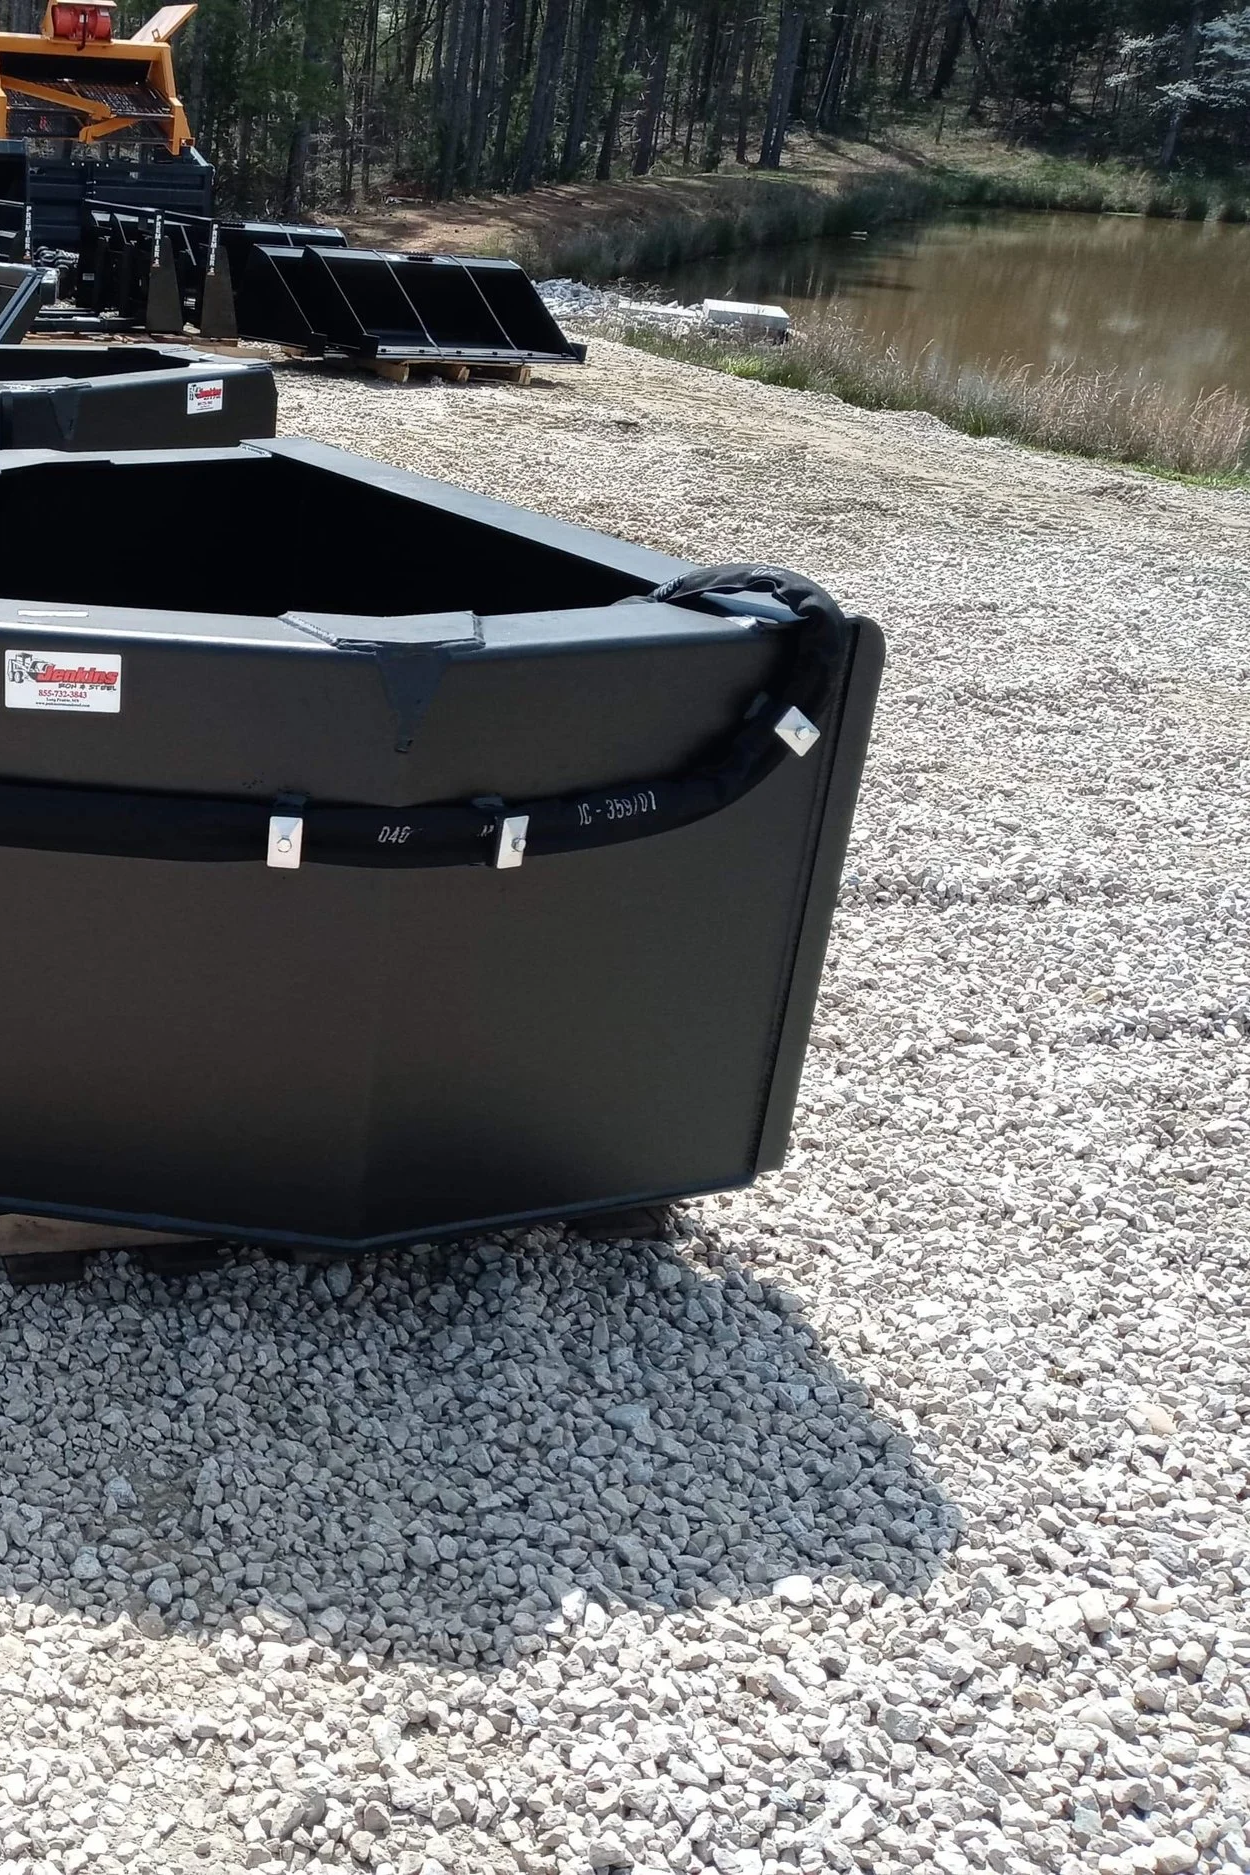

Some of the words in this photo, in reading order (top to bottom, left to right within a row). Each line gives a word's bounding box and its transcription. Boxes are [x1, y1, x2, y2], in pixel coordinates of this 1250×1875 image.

[24, 205, 32, 250] PREMIER
[154, 214, 163, 258] PREMIER
[209, 223, 219, 267] PREMIER
[36, 664, 119, 685] Jenkins
[38, 689, 88, 699] 855-732-3843
